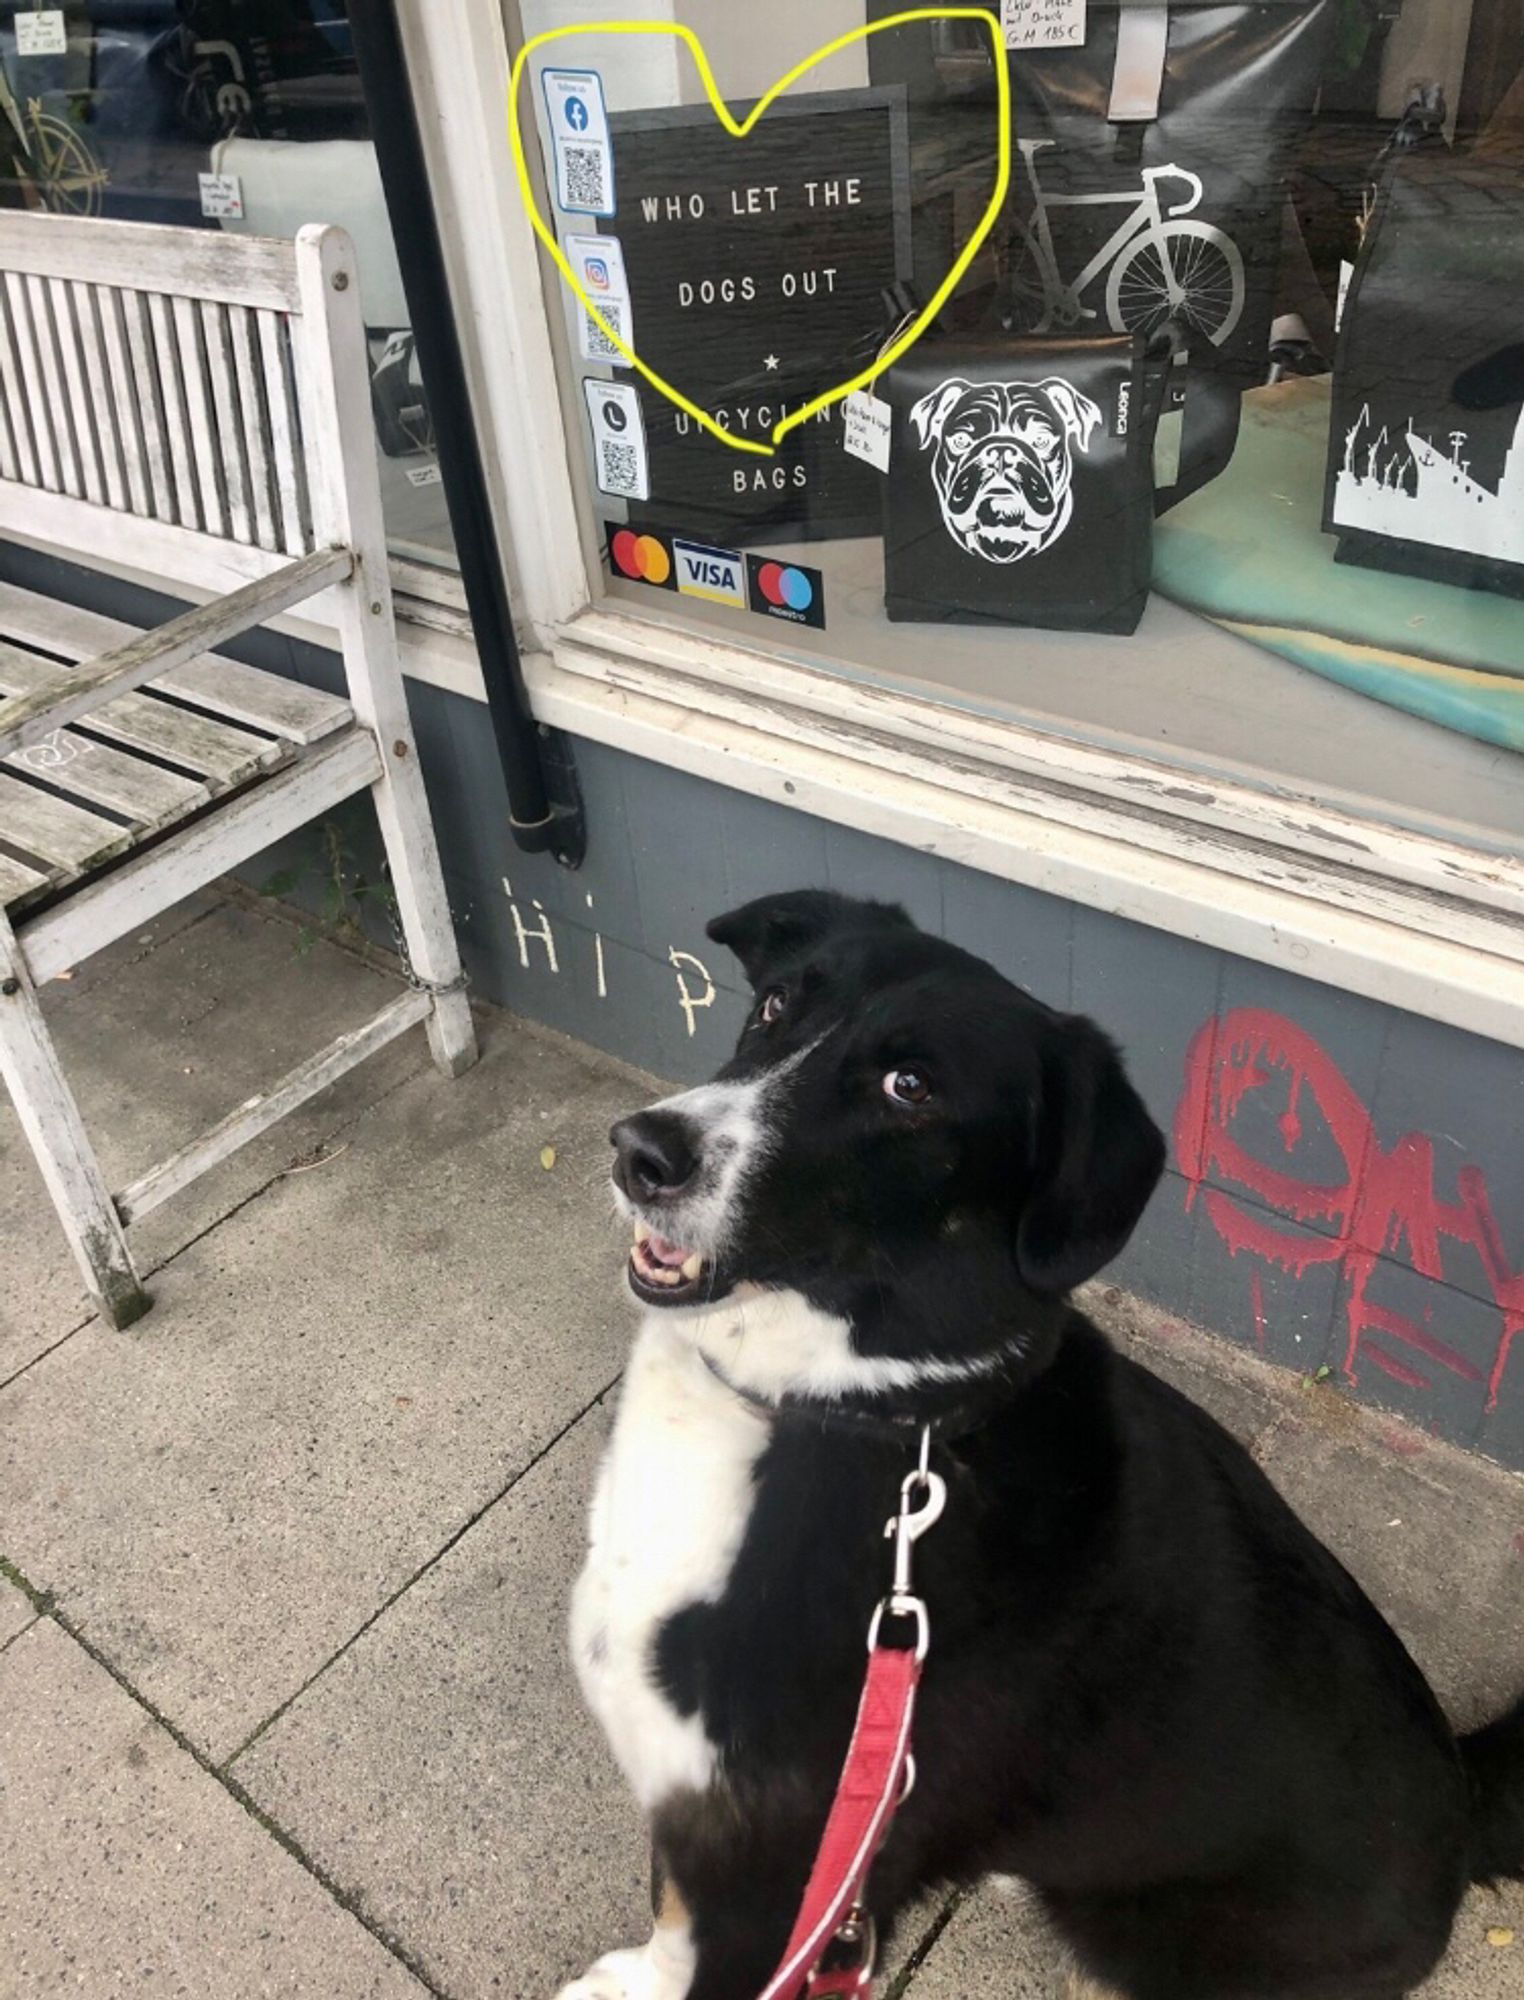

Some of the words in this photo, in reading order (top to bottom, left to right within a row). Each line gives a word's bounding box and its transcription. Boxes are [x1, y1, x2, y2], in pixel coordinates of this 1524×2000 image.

[641, 194, 705, 223] WHO
[731, 186, 779, 215] LET
[804, 178, 862, 207] THE
[678, 276, 756, 307] DOGS
[782, 268, 837, 297] OUT
[733, 465, 807, 493] BAGS
[683, 557, 736, 590] VISA
